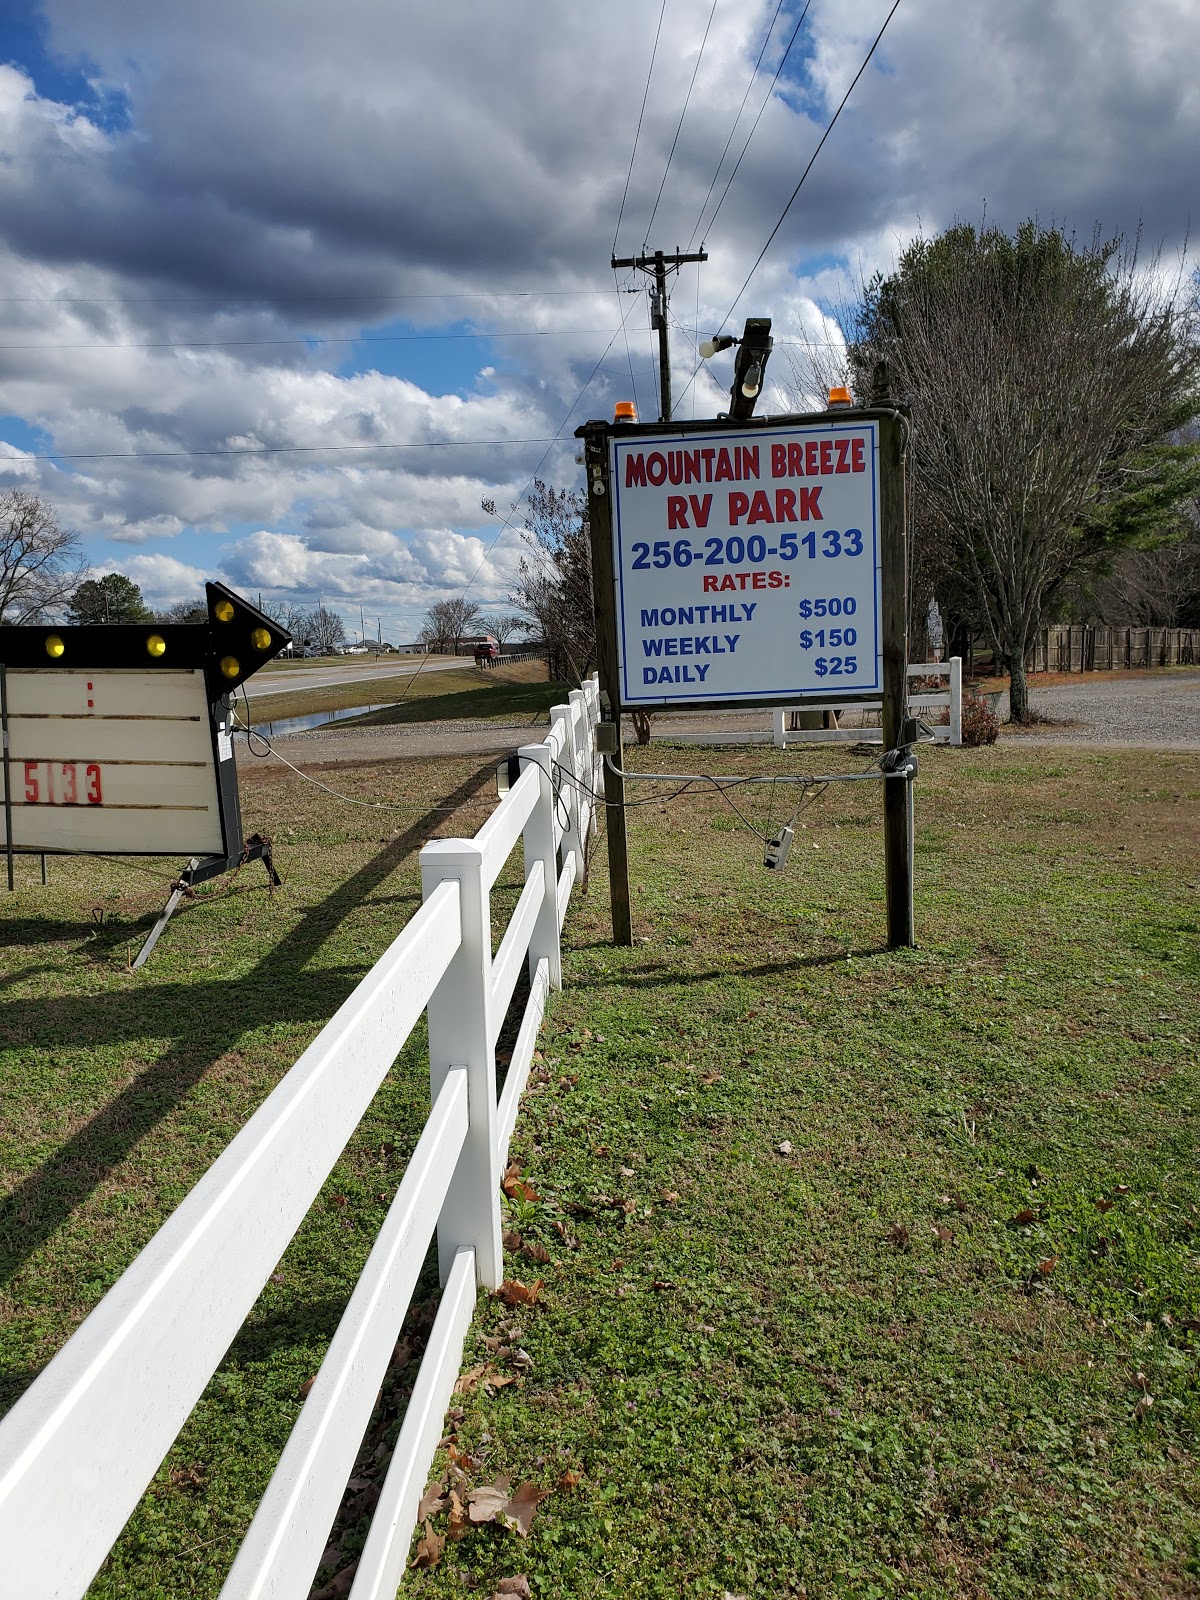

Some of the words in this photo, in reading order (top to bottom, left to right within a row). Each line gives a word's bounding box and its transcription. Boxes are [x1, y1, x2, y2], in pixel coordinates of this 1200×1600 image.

[625, 445, 760, 488] MOUNTAIN
[771, 438, 866, 479] BREEZE
[667, 493, 713, 530] RV
[728, 486, 824, 526] PARK
[631, 528, 864, 570] 256-200-5133
[703, 571, 791, 593] RATES:
[640, 603, 757, 627] MONTHLY
[799, 597, 857, 620] $500
[642, 634, 740, 657] WEEKLY
[799, 628, 857, 651] $150
[642, 663, 710, 685] DAILY
[814, 656, 857, 678] $25
[24, 762, 103, 803] 5133
